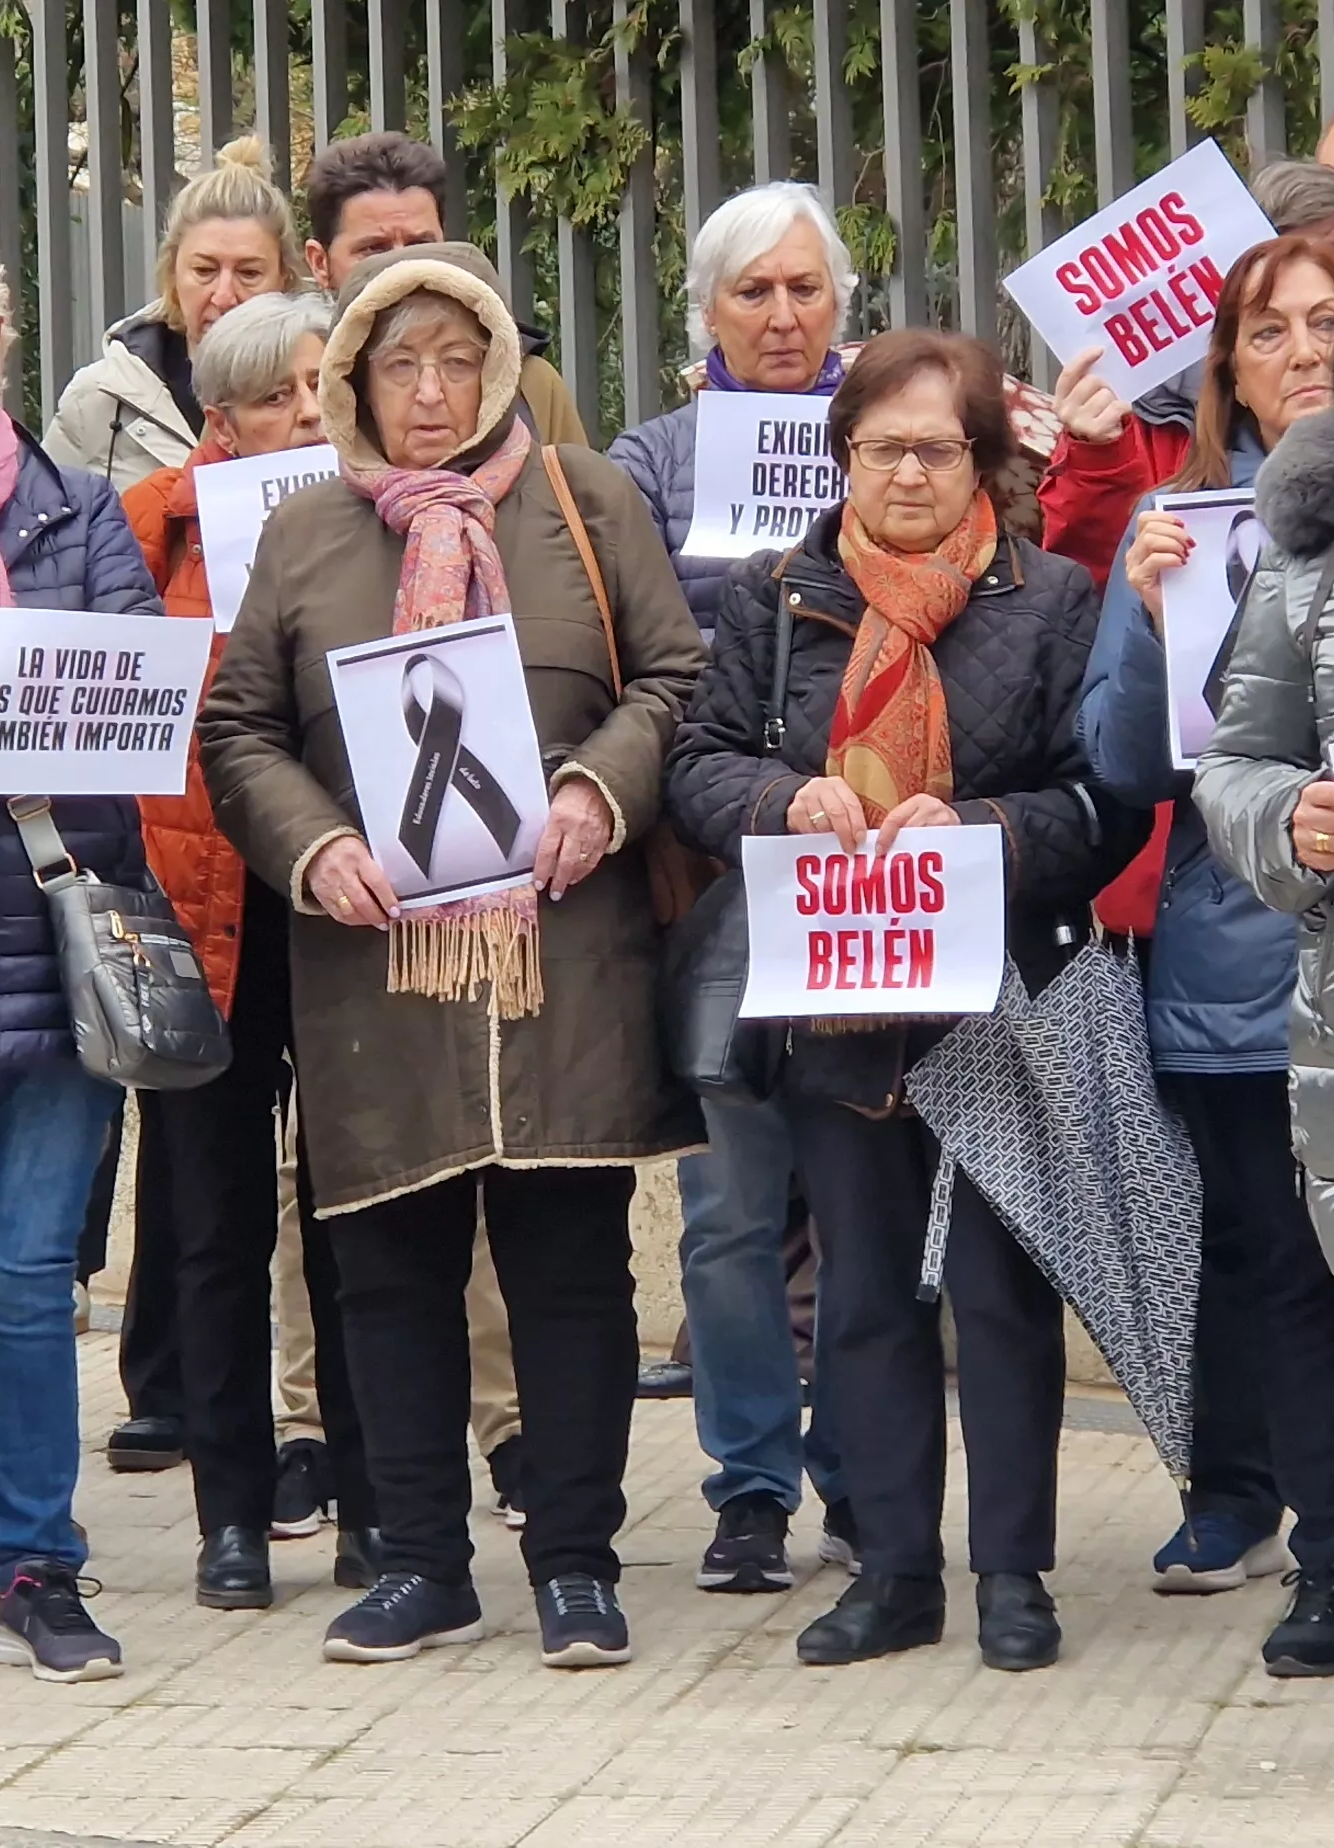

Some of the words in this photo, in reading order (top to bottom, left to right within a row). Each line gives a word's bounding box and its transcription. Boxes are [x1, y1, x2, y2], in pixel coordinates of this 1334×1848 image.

[1056, 191, 1205, 316] SOMOS
[1103, 256, 1225, 368] BELÉN
[752, 462, 849, 500] DERECH
[730, 503, 745, 535] Y
[753, 504, 828, 538] PROT
[18, 646, 45, 679] LA
[55, 648, 107, 681] VIDA
[115, 651, 146, 682] DE
[18, 685, 64, 716] QUE
[70, 686, 188, 717] CUIDAMOS
[75, 721, 175, 752] IMPORTA
[796, 851, 946, 915] SOMOS
[806, 917, 934, 990] BELÉN
